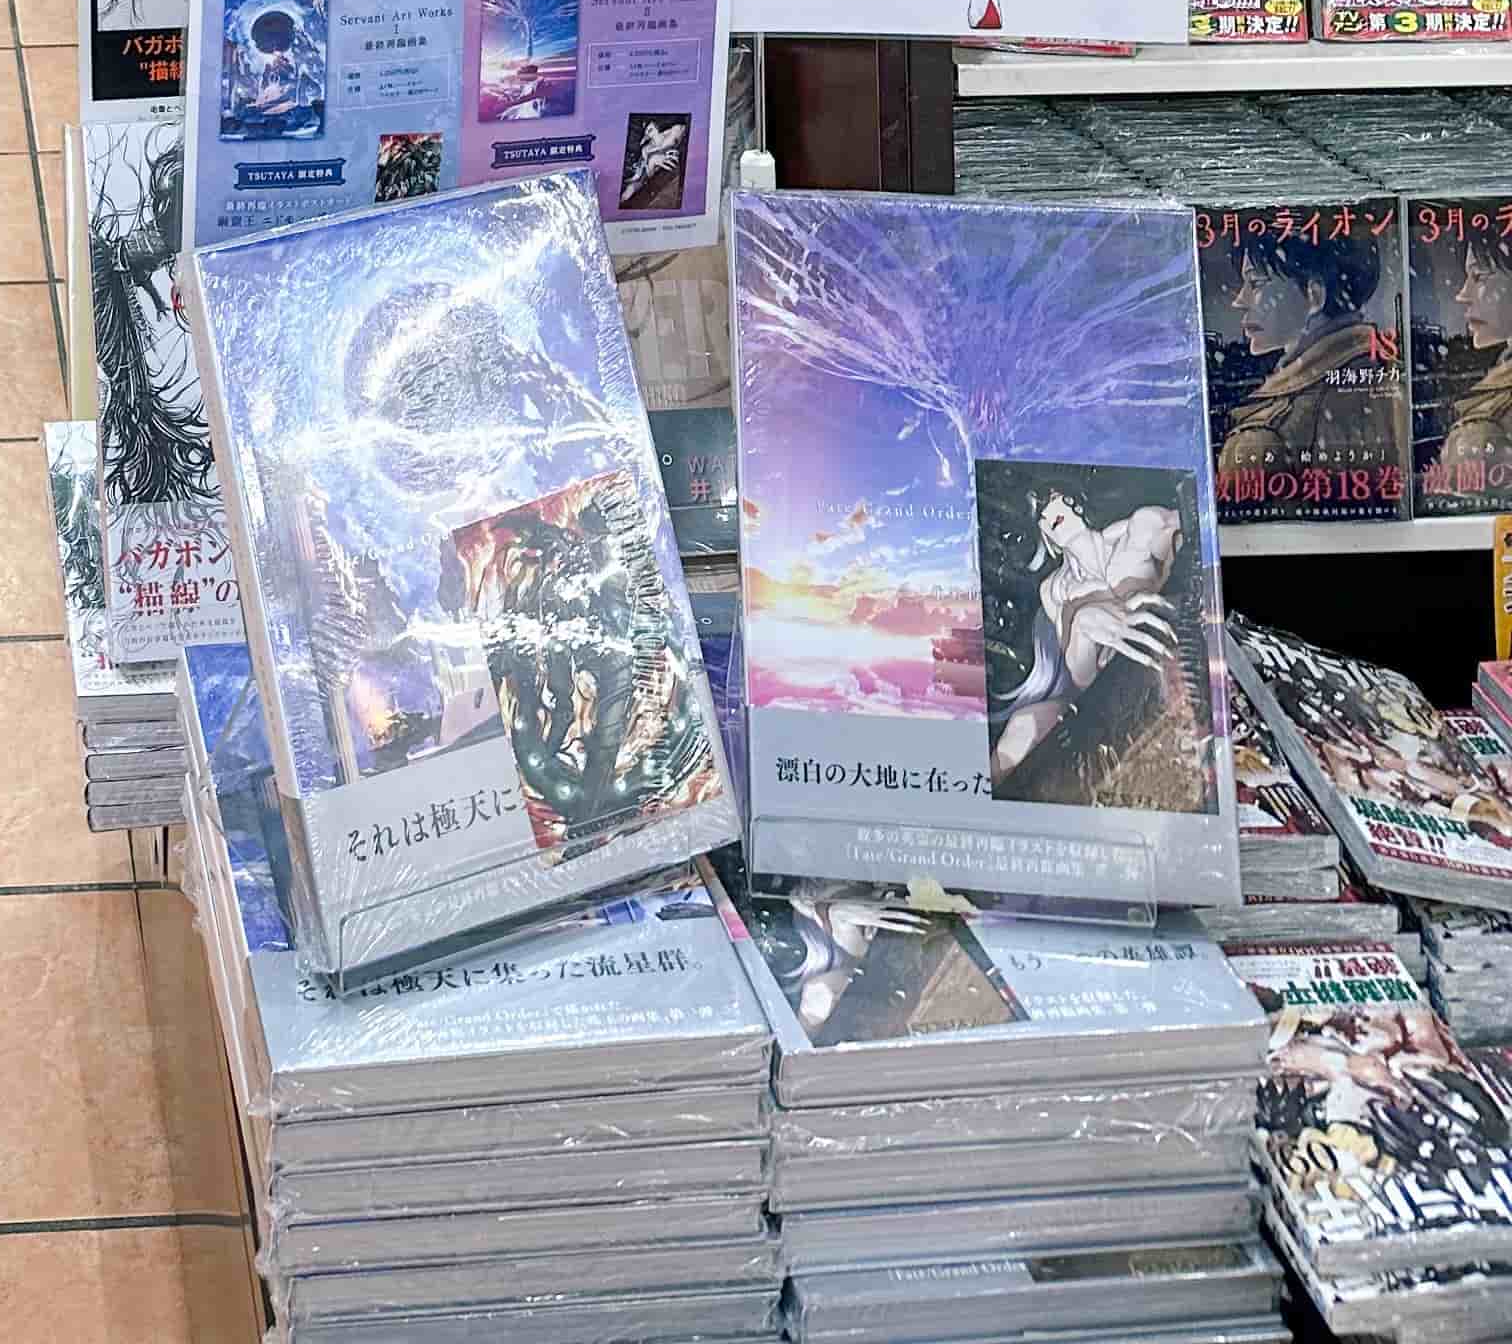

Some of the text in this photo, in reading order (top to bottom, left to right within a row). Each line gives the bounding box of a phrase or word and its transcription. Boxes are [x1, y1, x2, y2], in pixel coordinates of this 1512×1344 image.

[339, 7, 454, 26] Servant Art Works
[247, 170, 295, 181] TSUTAYA
[1197, 207, 1396, 249] 3月のライオン
[1367, 327, 1399, 363] 18
[775, 756, 992, 796] 漂白の大地に在った
[346, 786, 527, 862] それは極天に
